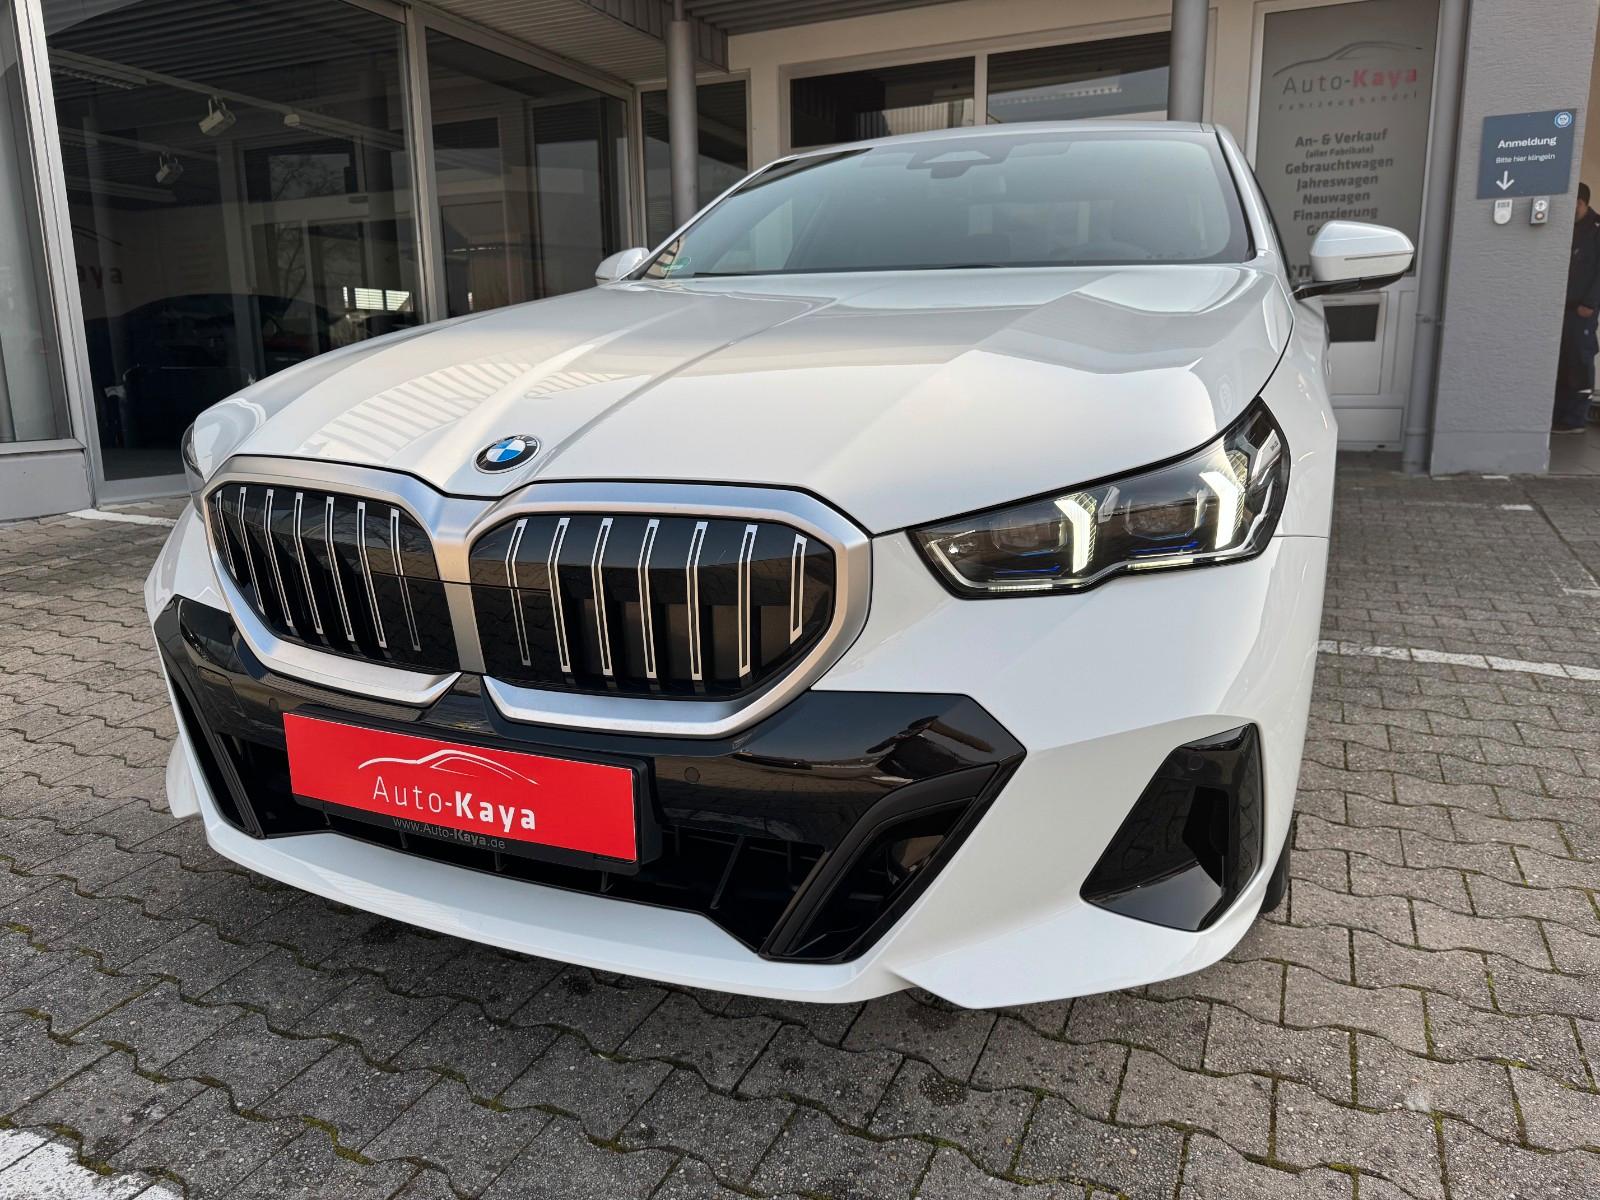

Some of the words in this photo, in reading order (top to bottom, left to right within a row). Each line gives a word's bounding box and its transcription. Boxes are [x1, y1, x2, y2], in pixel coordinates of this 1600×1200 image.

[1282, 68, 1417, 95] Auto-Kaya
[1295, 136, 1319, 148] An-
[1321, 134, 1331, 146] &
[1334, 128, 1388, 145] Verkauf
[1498, 137, 1557, 149] Anmeldung
[1285, 158, 1393, 175] Gebrauchtwagen
[1296, 175, 1378, 192] Jahreswagen
[1303, 192, 1370, 205] Neuwagen
[1293, 207, 1378, 221] Finanzierung
[372, 775, 537, 833] Auto-Kaya
[392, 817, 506, 850] www.Auto-Kaya.de
